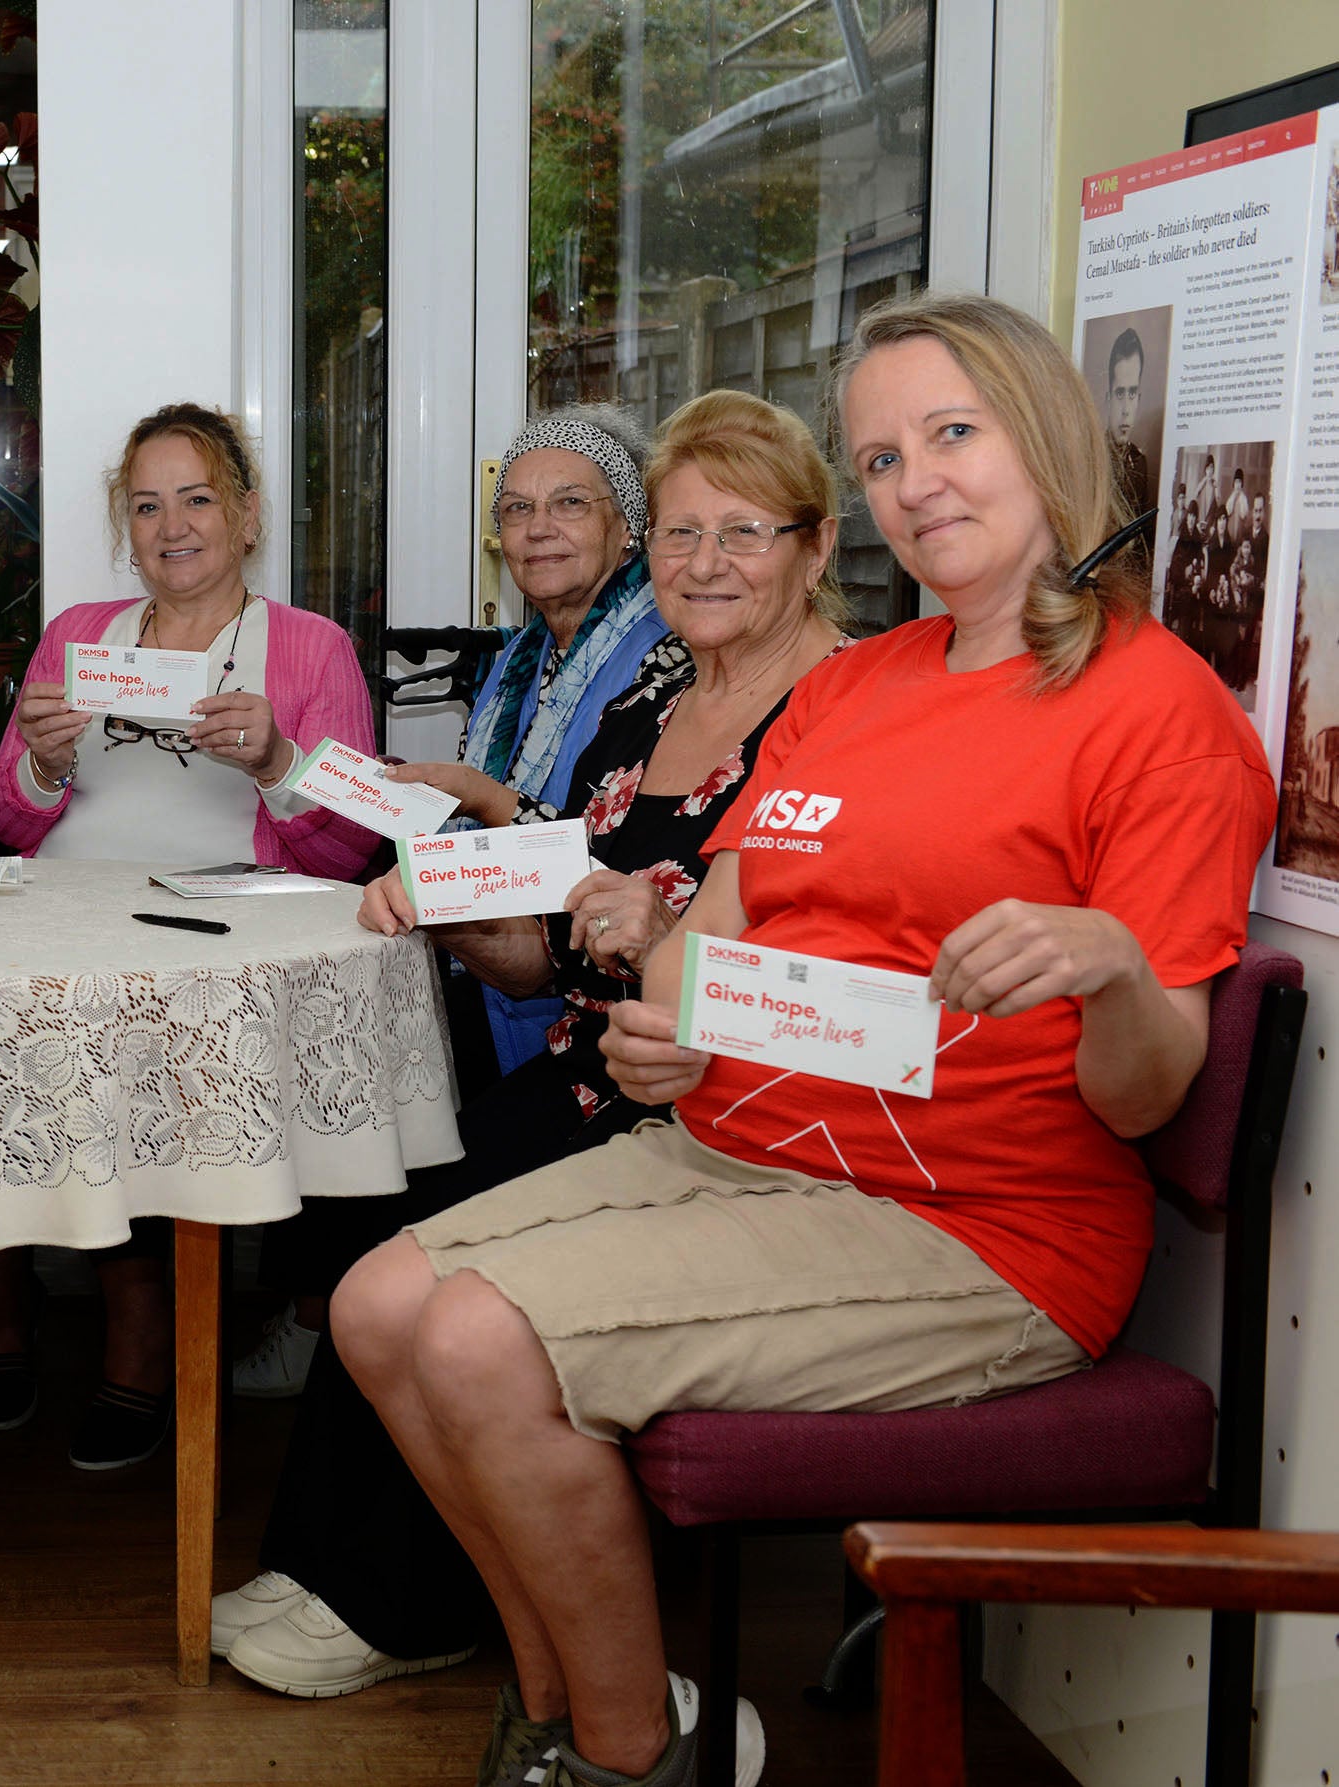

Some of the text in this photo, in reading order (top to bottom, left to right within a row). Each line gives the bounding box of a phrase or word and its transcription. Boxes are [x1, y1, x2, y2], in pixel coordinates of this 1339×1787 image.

[1088, 234, 1115, 255] Turkish
[1117, 229, 1149, 252] Cypriots
[1157, 216, 1190, 239] Britain's
[1192, 212, 1231, 234] forgotten
[1232, 201, 1270, 222] soldiers:
[1086, 260, 1110, 279] Cemal
[1110, 253, 1140, 274] Mustafa
[1149, 250, 1161, 266] the
[1162, 244, 1190, 263] soldier
[1192, 239, 1210, 257] who
[1211, 238, 1236, 253] never
[1237, 227, 1257, 248] died
[78, 649, 103, 657] DKMS
[78, 670, 144, 686] Give hope,
[116, 686, 144, 699] save
[332, 745, 356, 761] DKMS
[319, 761, 348, 780] Give
[348, 775, 382, 799] hope,
[346, 790, 378, 806] save
[413, 840, 445, 853] DKMS
[776, 837, 823, 854] CANCER
[419, 865, 506, 884] Give hope,
[473, 879, 509, 899] save
[707, 945, 747, 964] DKMS
[705, 981, 755, 1006] Give
[761, 991, 821, 1022] hope,
[770, 1019, 820, 1040] save
